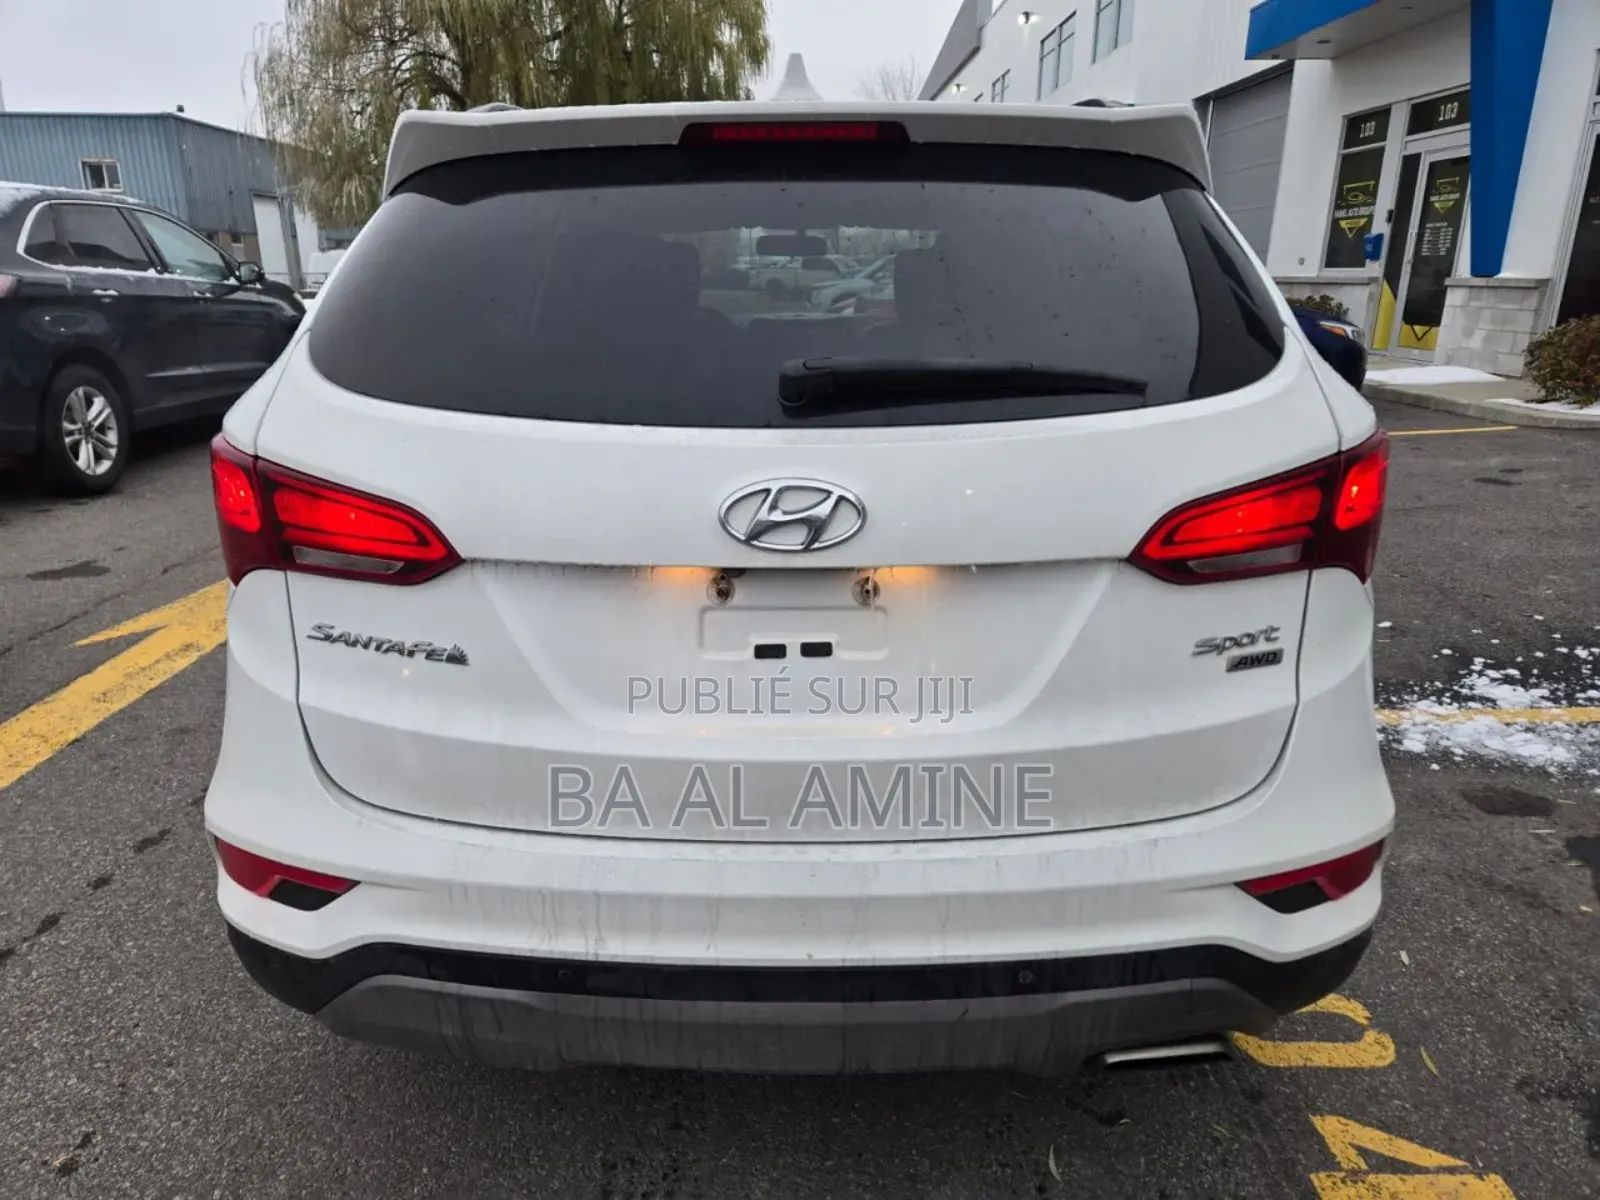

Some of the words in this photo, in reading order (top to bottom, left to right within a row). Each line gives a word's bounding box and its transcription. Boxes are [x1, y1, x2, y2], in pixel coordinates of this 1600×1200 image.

[1438, 101, 1459, 122] 103
[1359, 120, 1376, 138] 103
[1191, 625, 1280, 656] Sport
[1230, 650, 1279, 670] AWD
